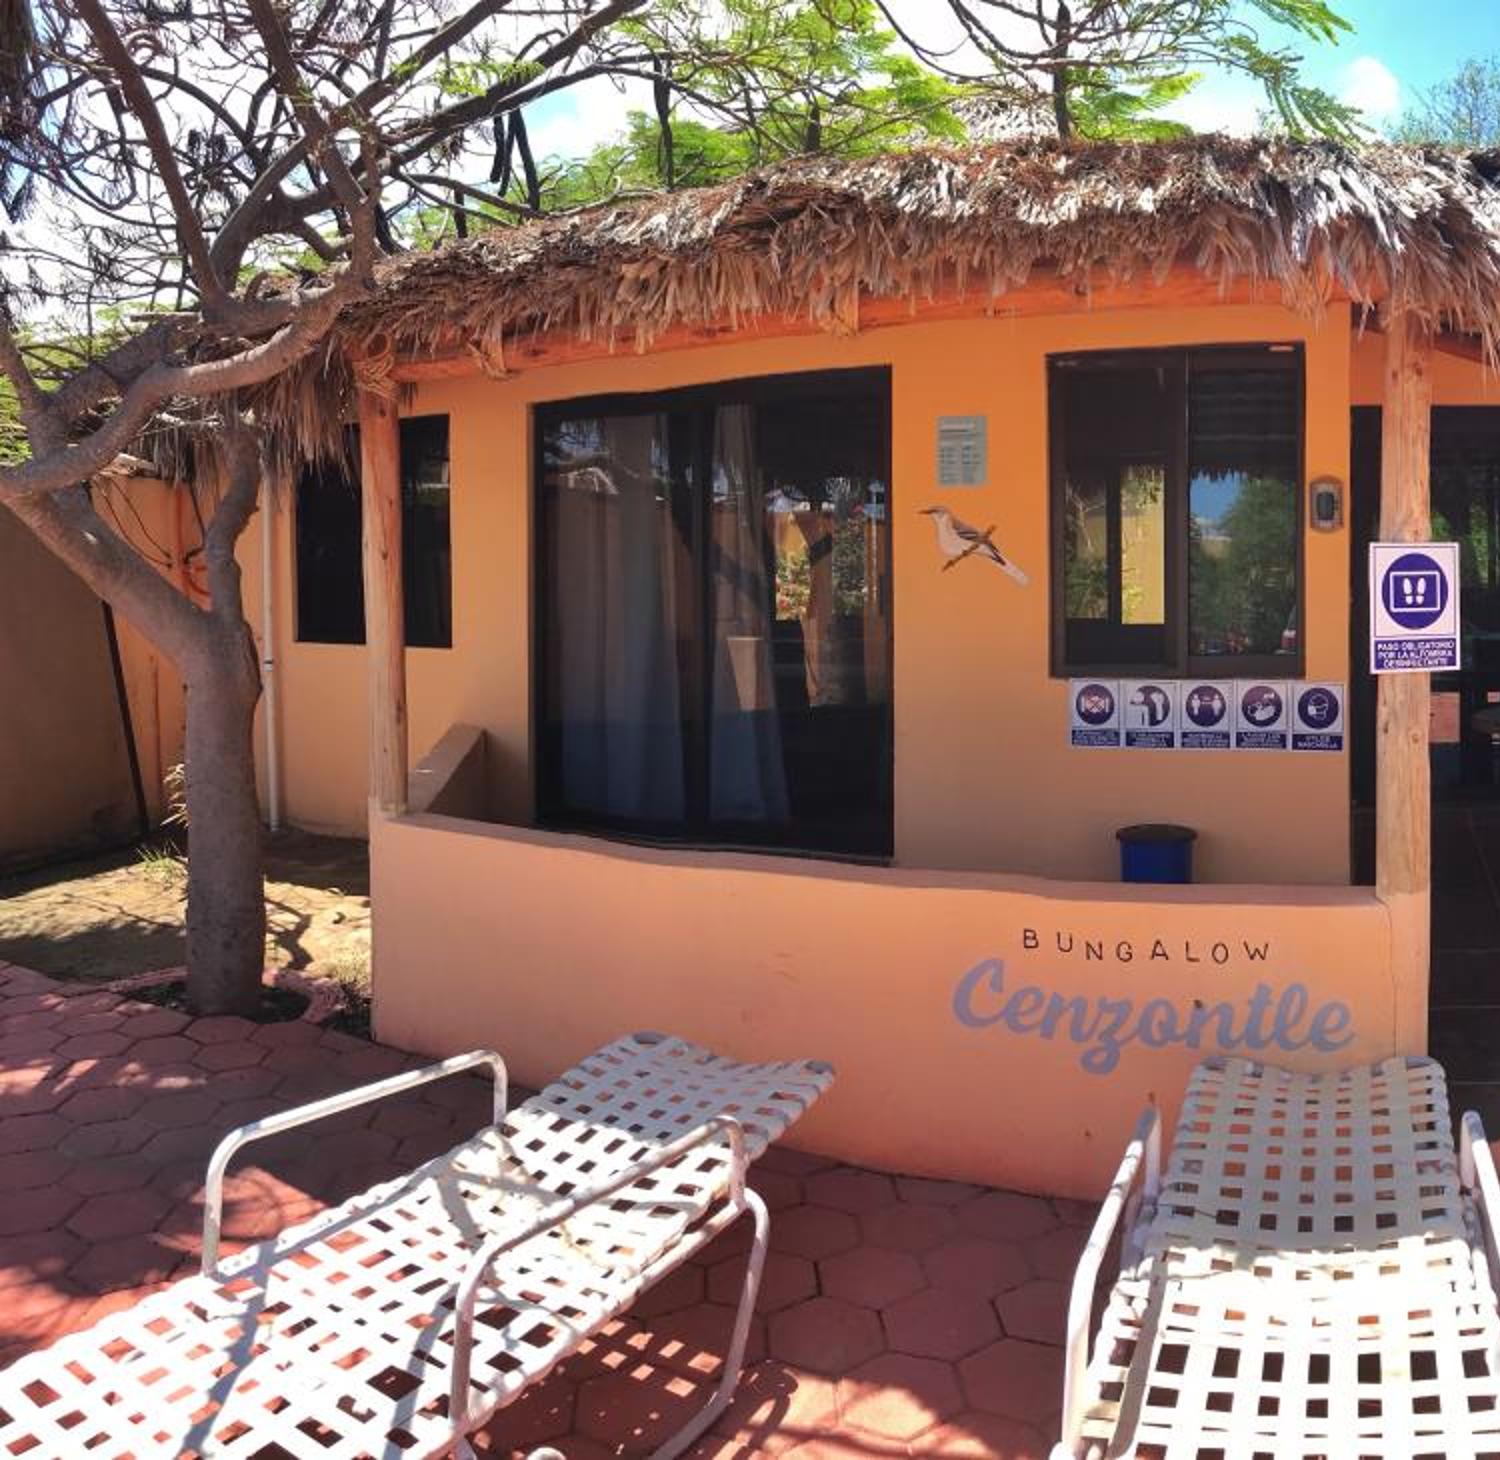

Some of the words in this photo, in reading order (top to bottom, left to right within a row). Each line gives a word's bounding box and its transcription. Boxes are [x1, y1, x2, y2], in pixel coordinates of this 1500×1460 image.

[1377, 642, 1399, 651] PASO
[1401, 640, 1455, 651] OBLIGATORIO
[1377, 651, 1396, 660] POR
[1397, 651, 1408, 659] LA
[1022, 928, 1271, 965] BUNGALOW
[953, 957, 1357, 1076] Cenzontle
